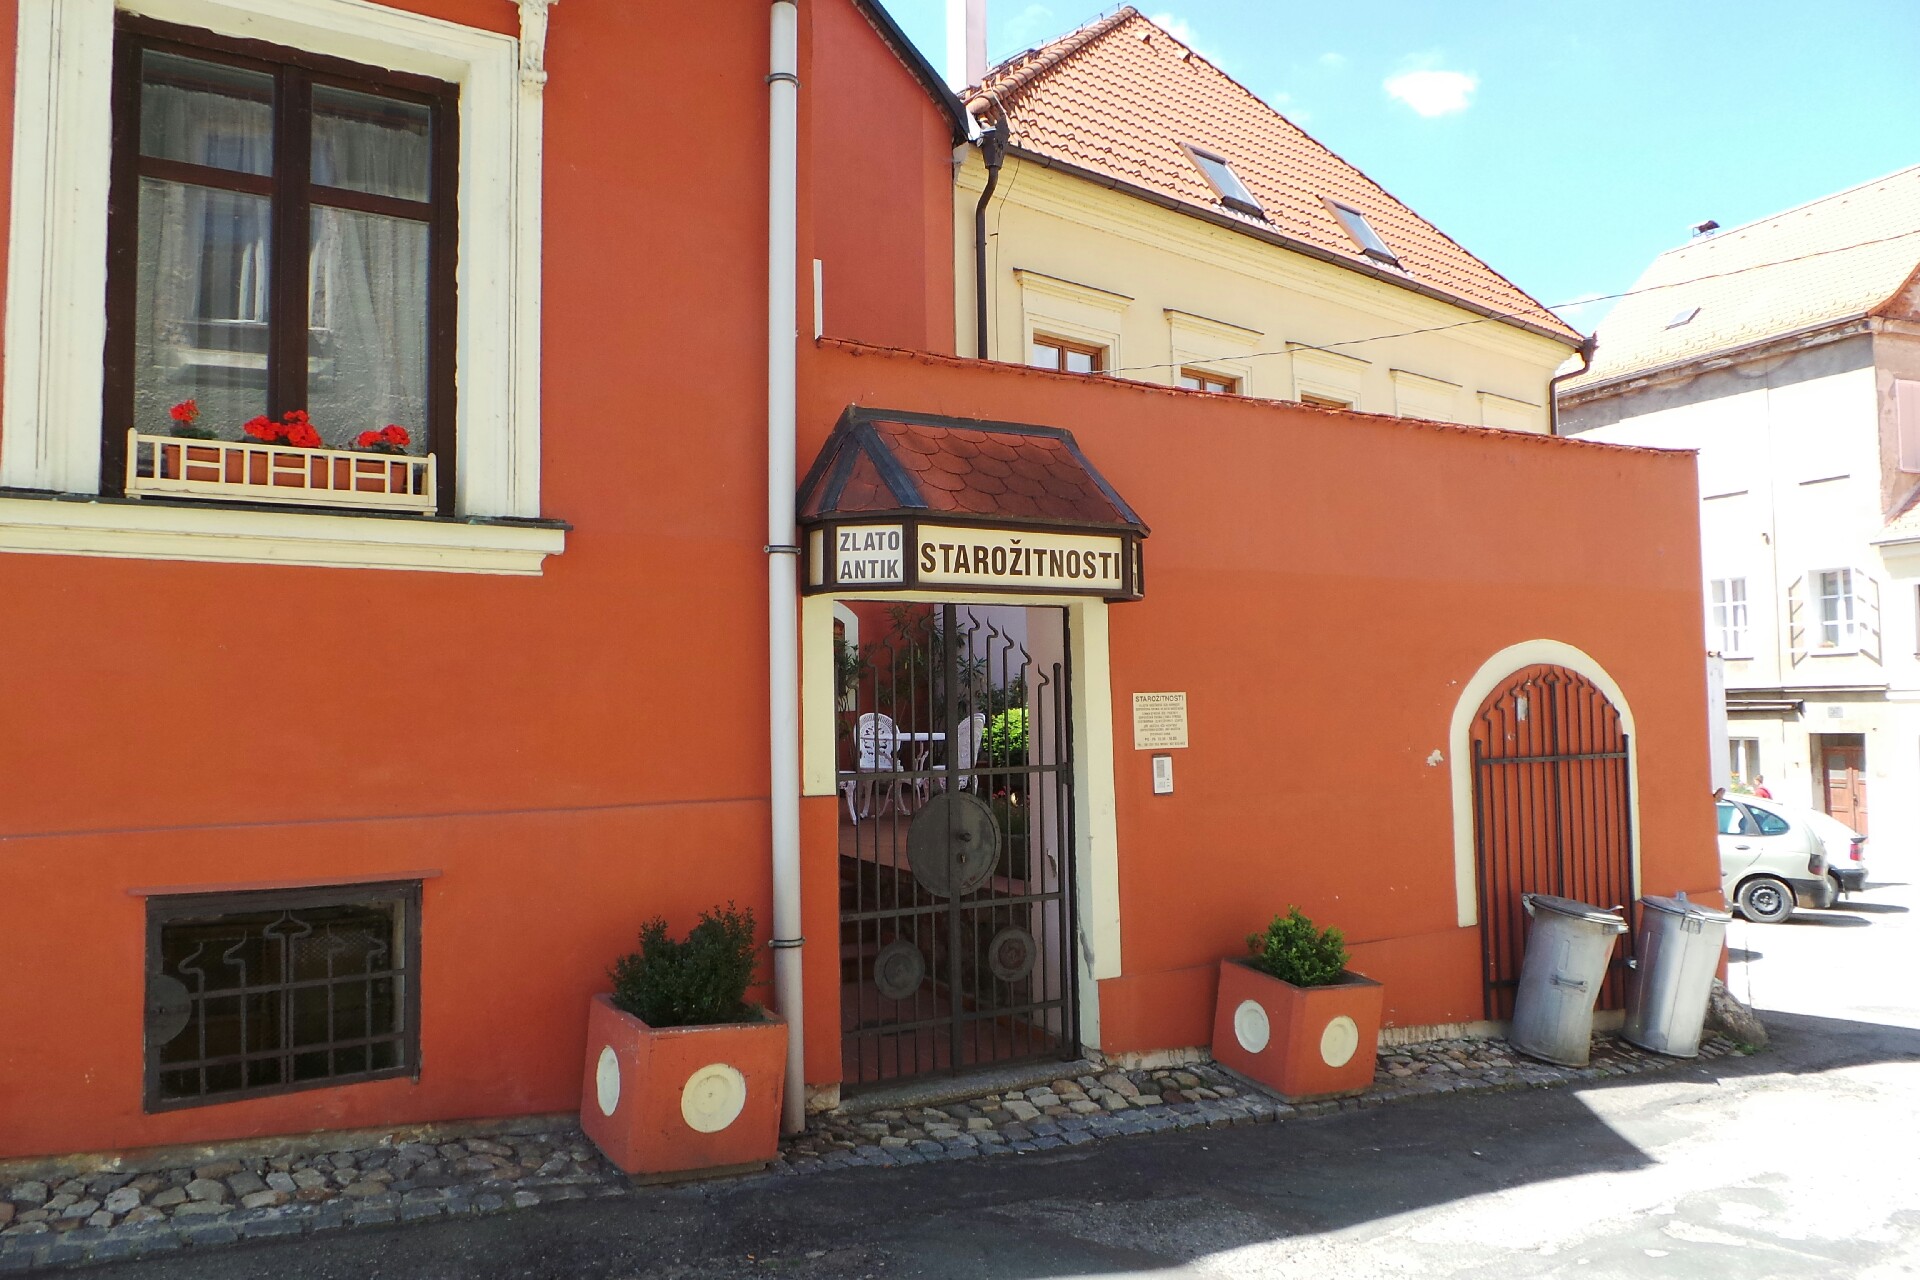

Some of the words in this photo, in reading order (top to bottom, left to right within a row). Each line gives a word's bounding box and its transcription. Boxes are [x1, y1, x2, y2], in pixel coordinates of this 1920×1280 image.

[840, 531, 900, 552] ZLATO
[840, 560, 899, 579] ANTIK
[920, 539, 1120, 580] STAROŽITNOSTI
